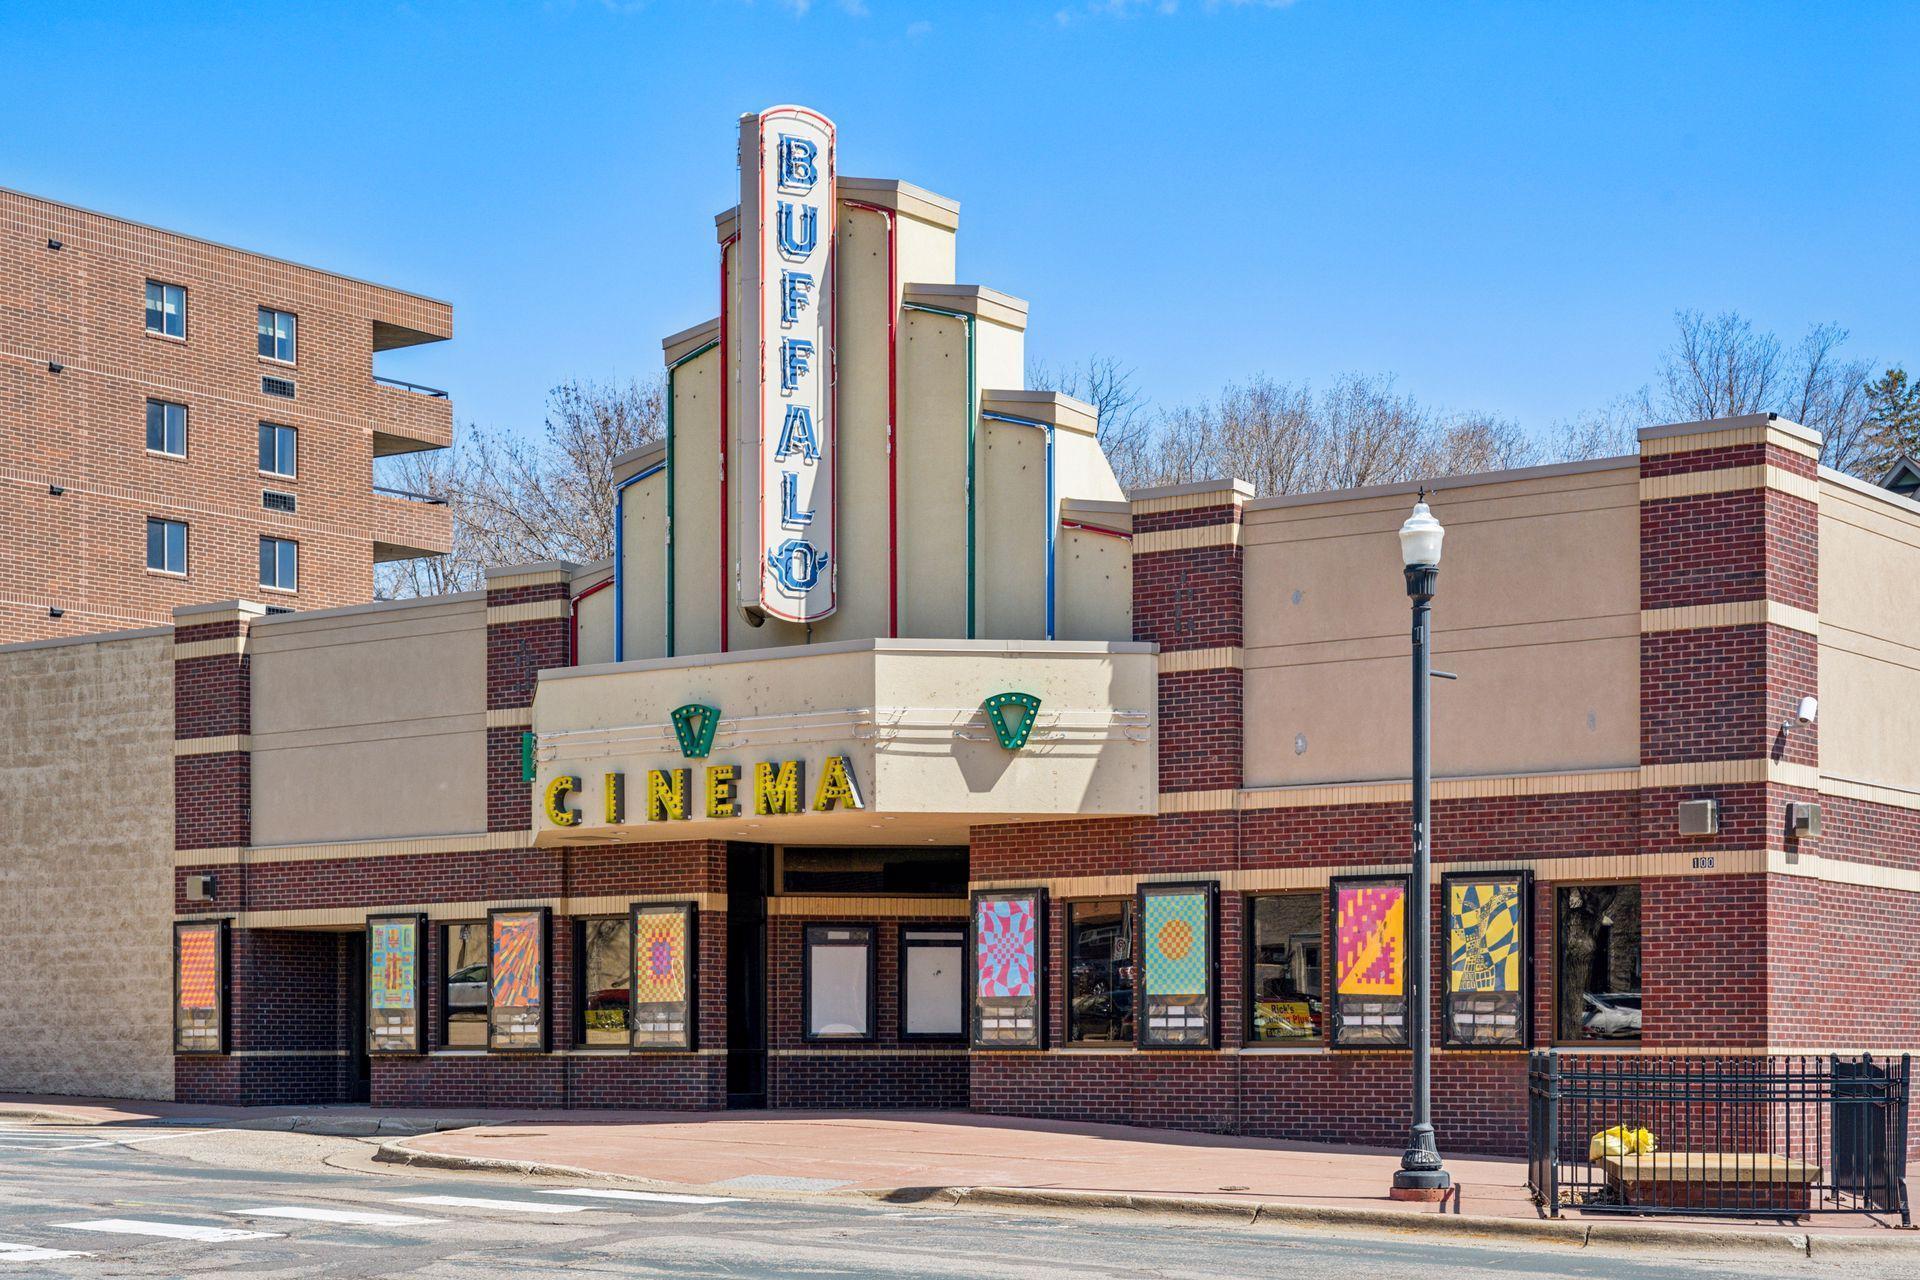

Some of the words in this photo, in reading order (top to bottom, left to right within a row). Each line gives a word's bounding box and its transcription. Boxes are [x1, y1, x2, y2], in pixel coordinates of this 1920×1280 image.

[768, 131, 829, 598] BUFFALO
[544, 752, 865, 827] CINEMA
[1692, 857, 1715, 868] 100
